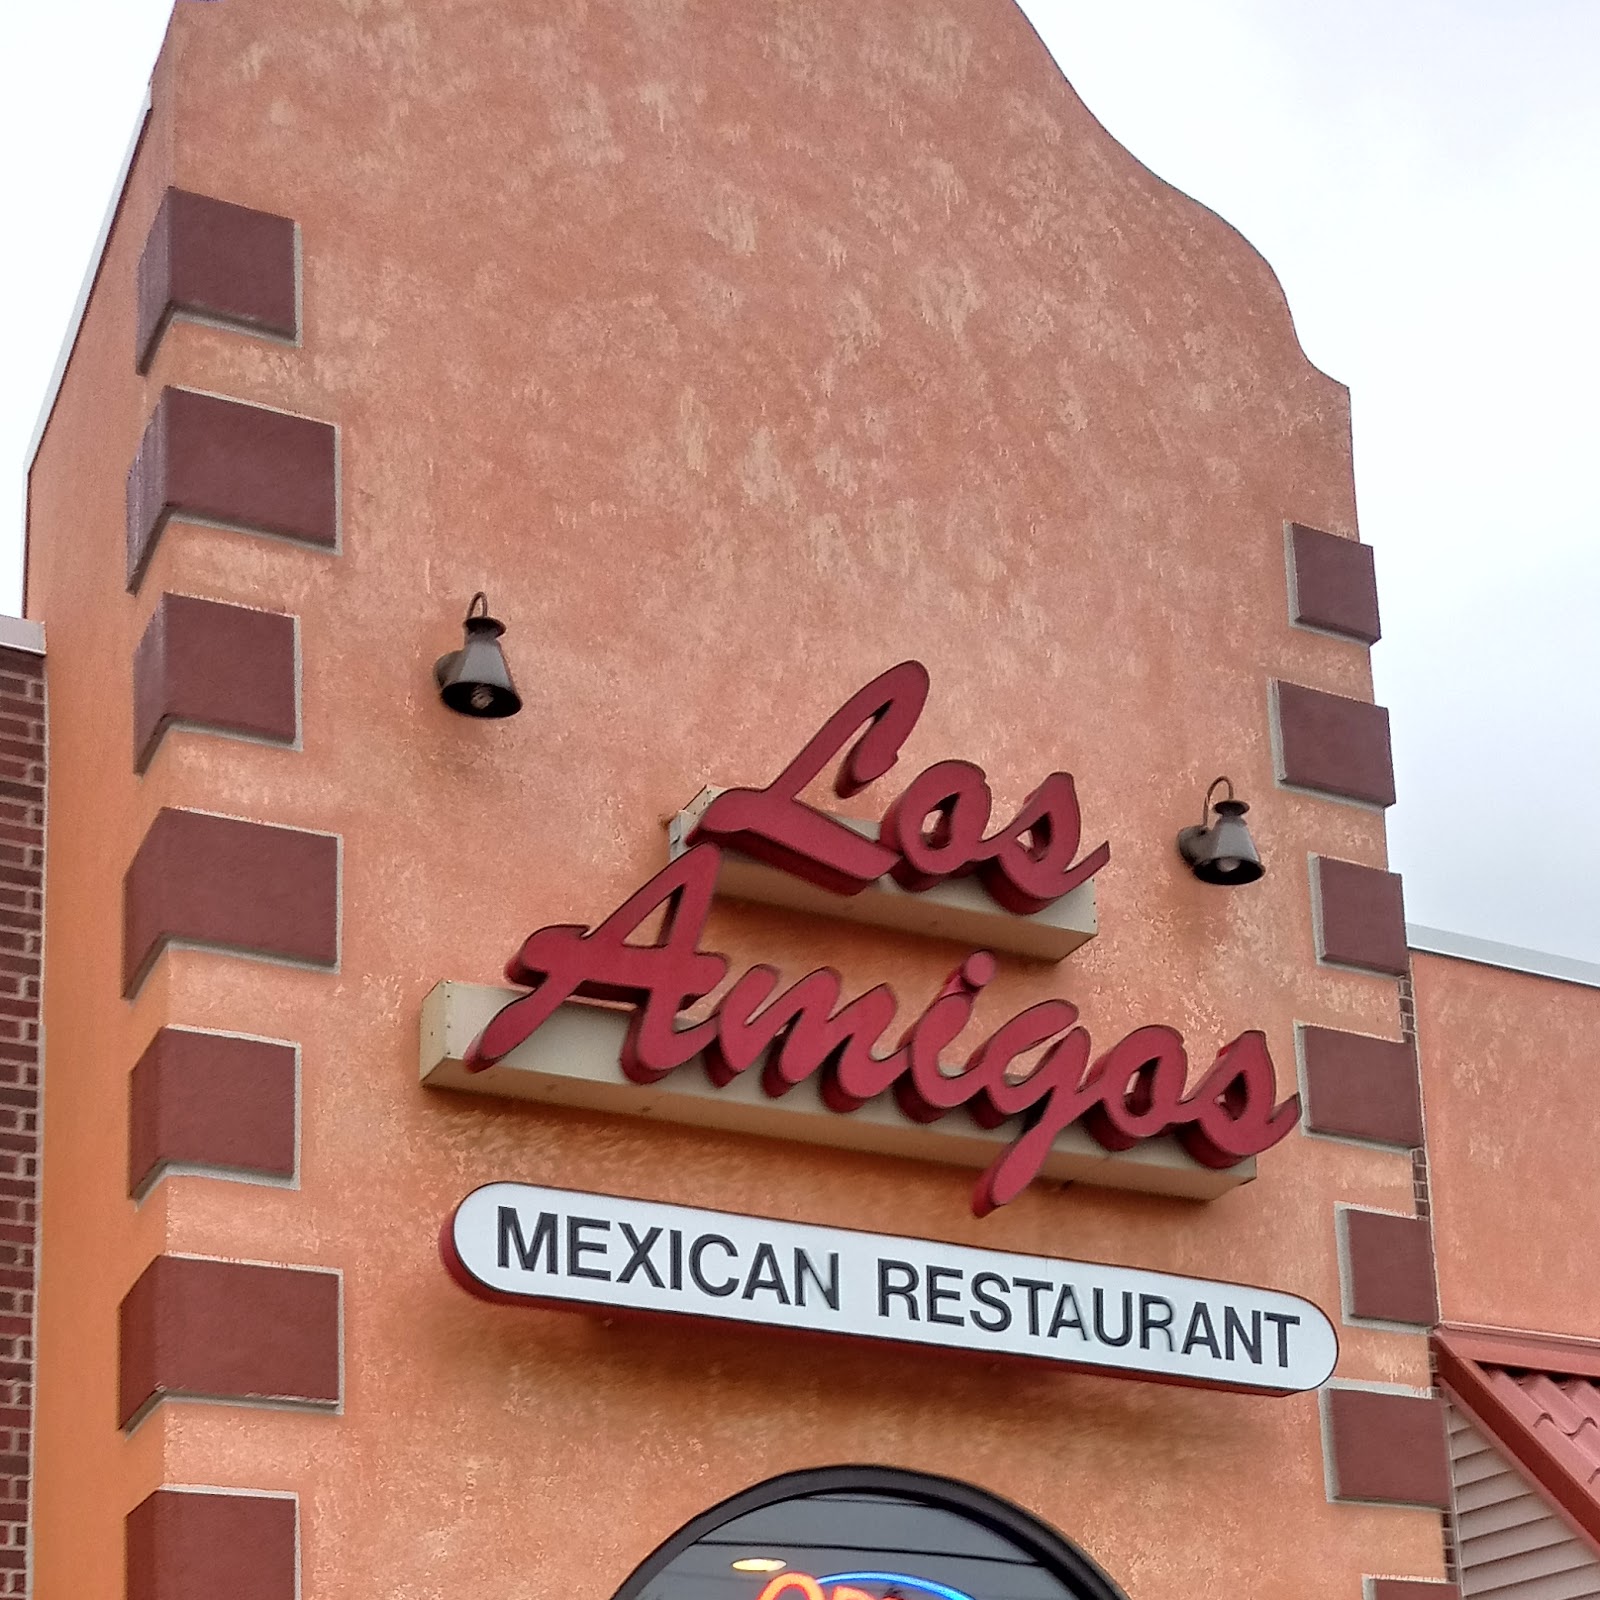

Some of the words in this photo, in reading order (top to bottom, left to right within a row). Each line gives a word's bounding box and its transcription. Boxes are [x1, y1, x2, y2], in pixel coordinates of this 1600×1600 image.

[686, 661, 1109, 913] Los
[462, 844, 1301, 1218] Amigos
[495, 1206, 839, 1310] MEXICAN
[877, 1259, 1300, 1368] RESTAURANT
